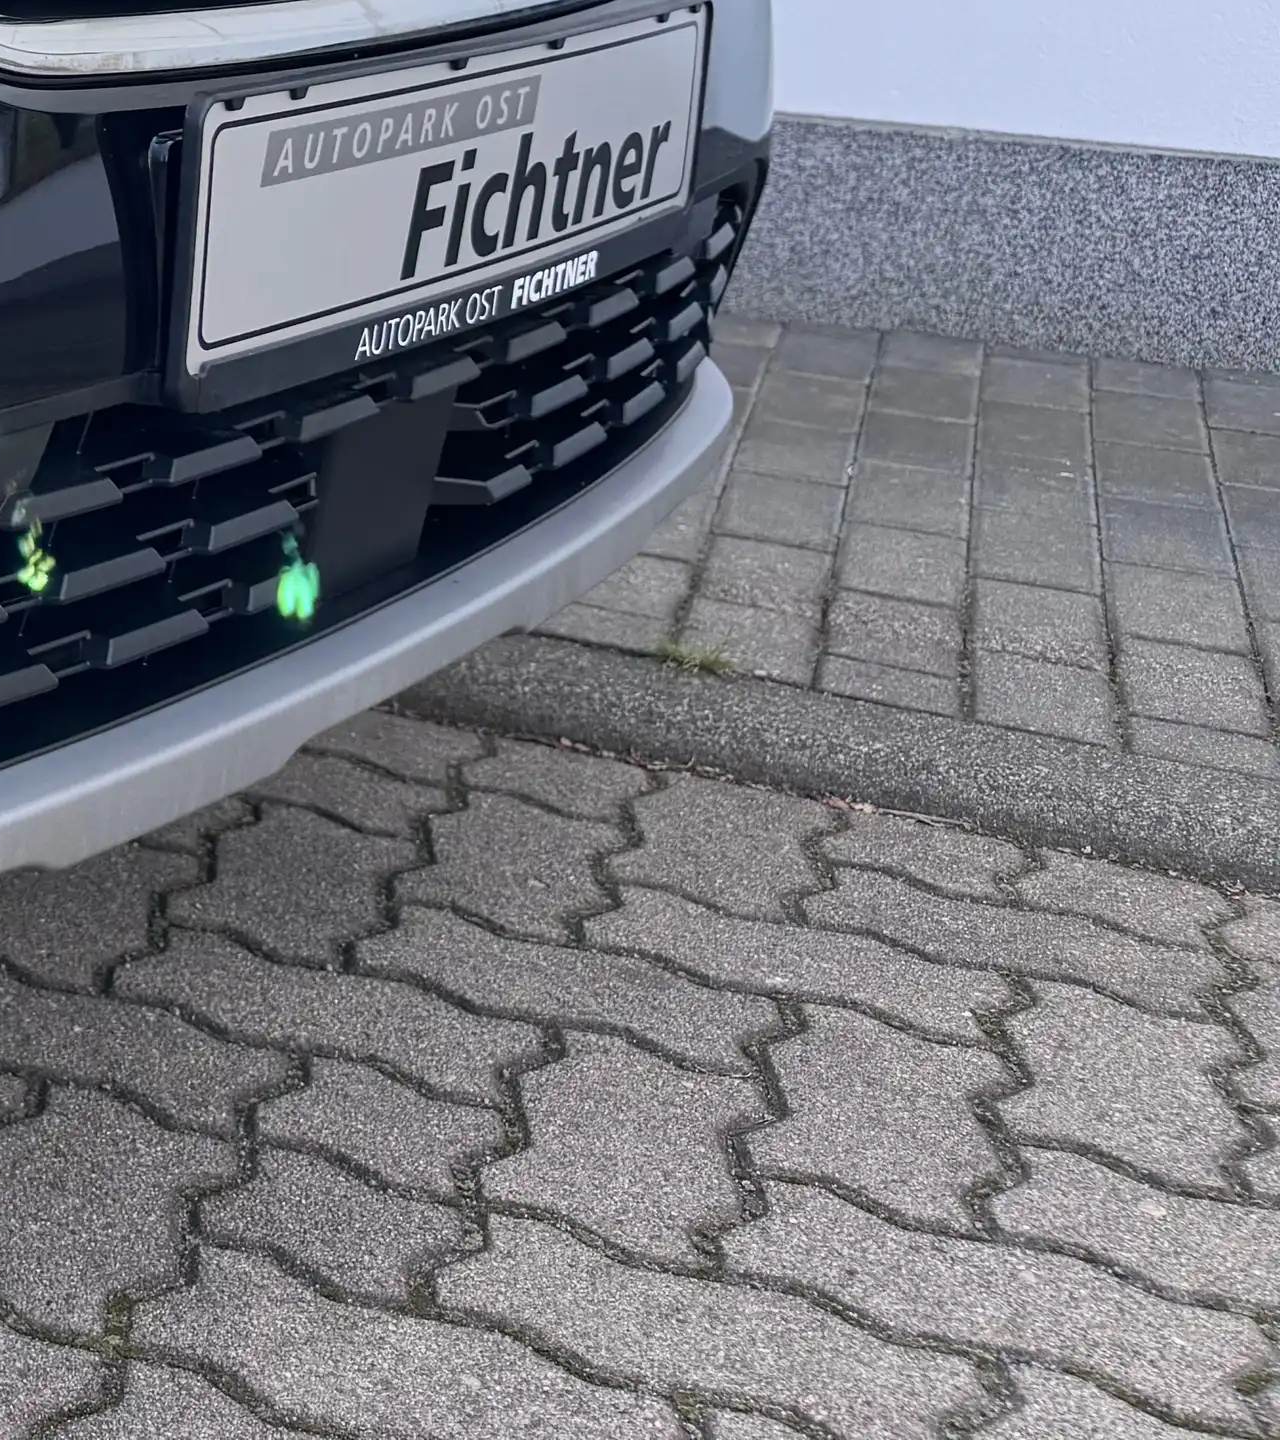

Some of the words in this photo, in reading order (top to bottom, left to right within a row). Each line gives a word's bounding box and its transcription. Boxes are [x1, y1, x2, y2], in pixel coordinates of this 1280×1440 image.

[273, 103, 459, 176] AUTOPARK
[476, 86, 531, 126] OST
[400, 120, 672, 280] Fichtner
[355, 299, 462, 360] AUTOPARK
[466, 286, 503, 323] OST
[510, 251, 599, 309] FICHTNER
